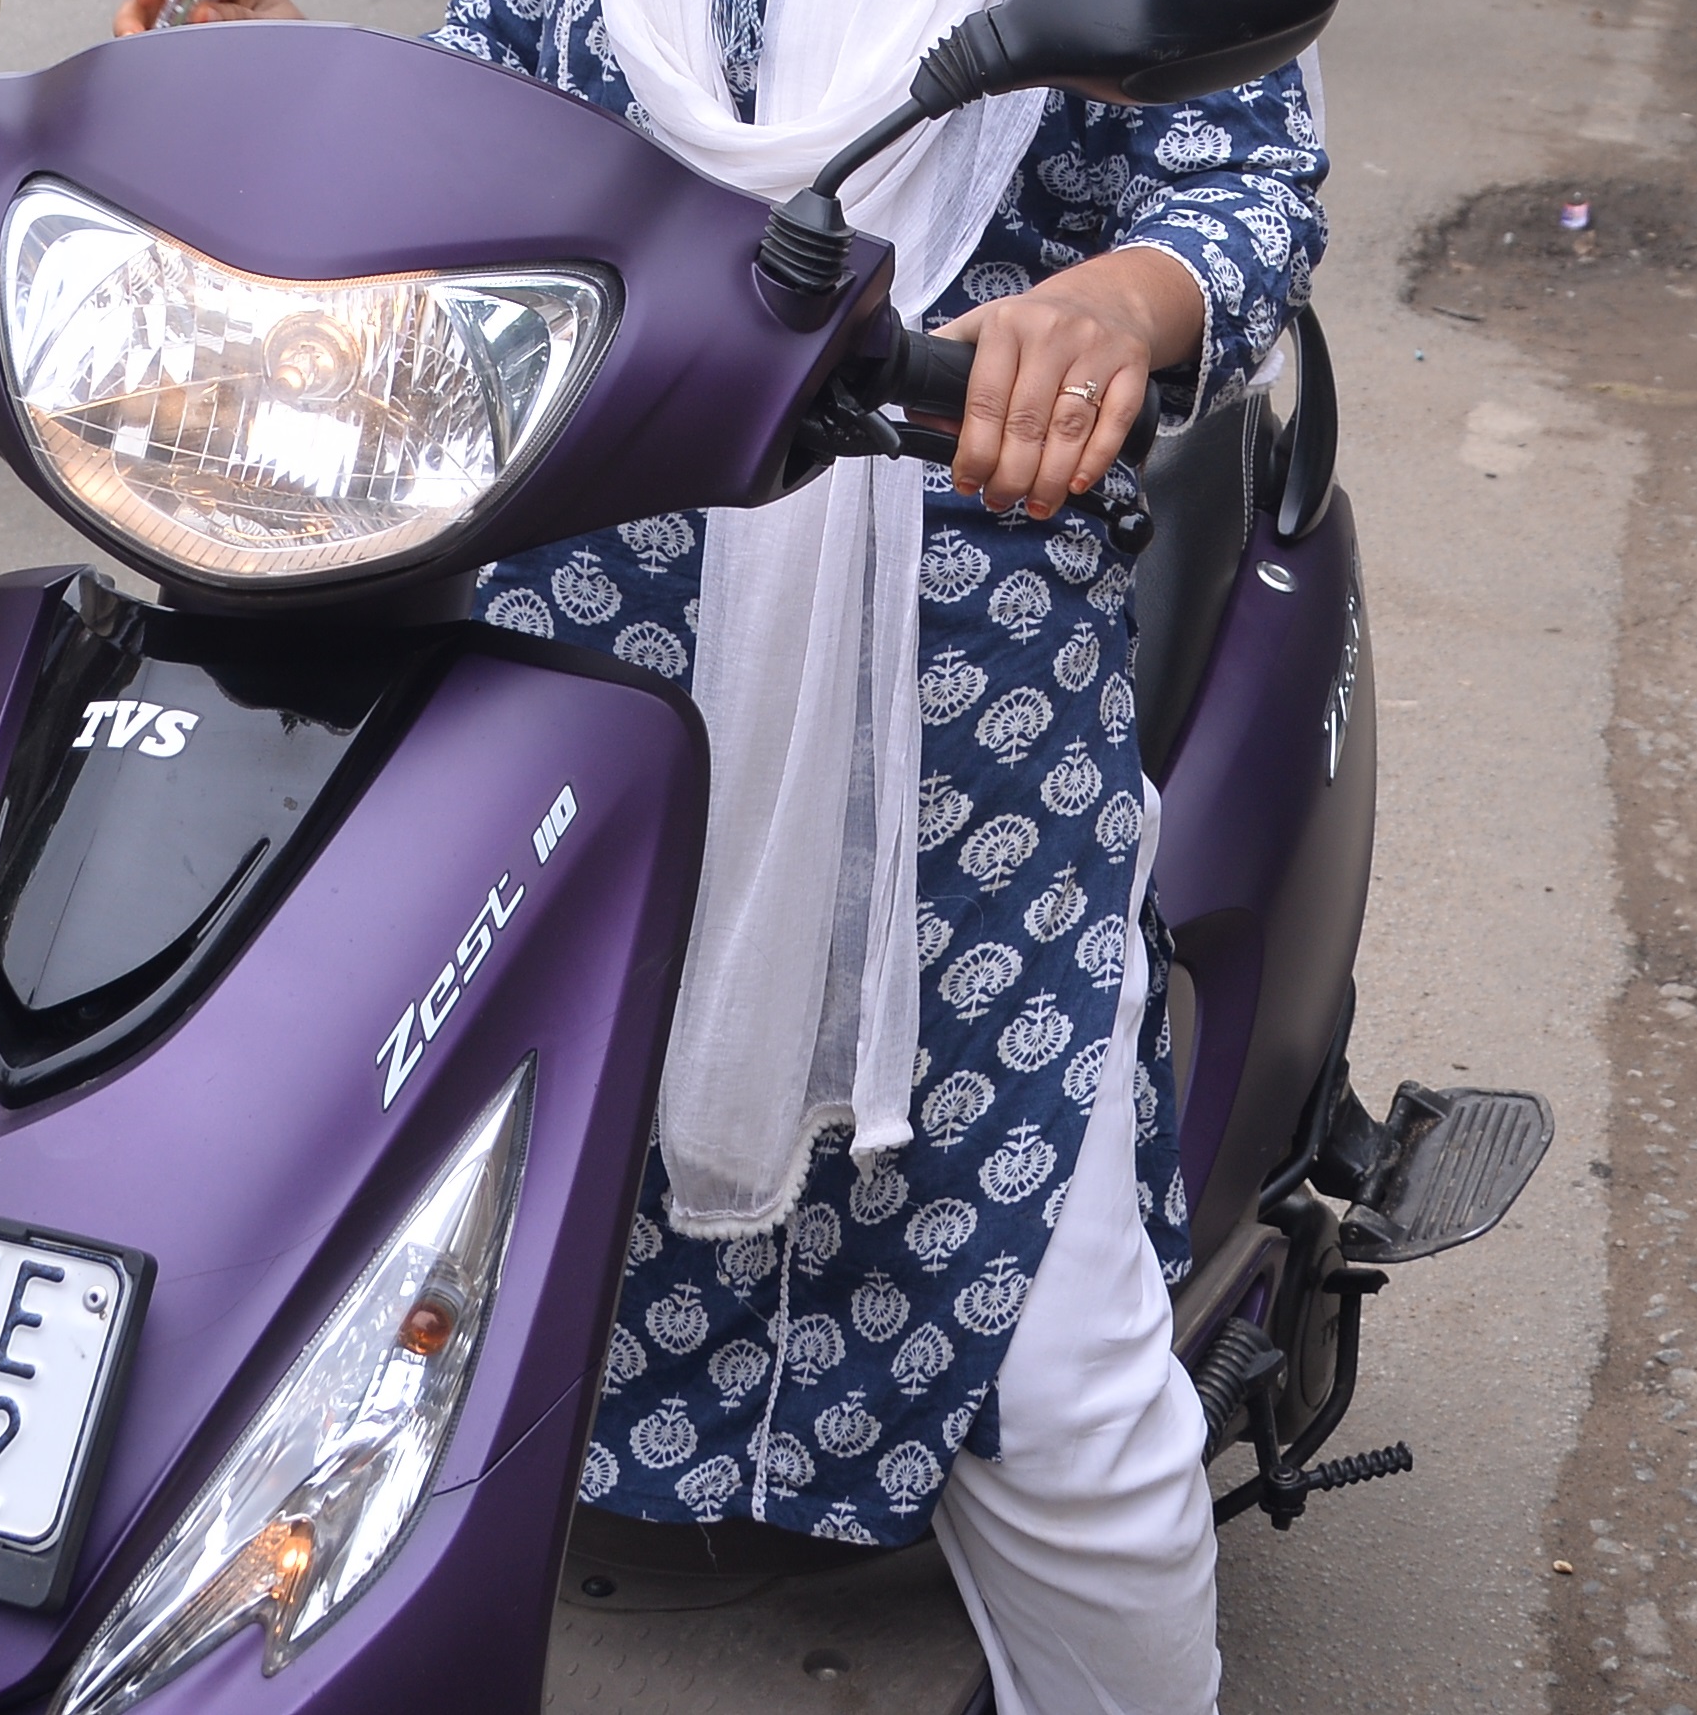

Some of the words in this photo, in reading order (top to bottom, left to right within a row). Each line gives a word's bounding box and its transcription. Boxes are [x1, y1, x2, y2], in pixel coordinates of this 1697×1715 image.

[72, 700, 199, 758] TVS
[376, 871, 524, 1112] Zest
[532, 784, 579, 866] 110
